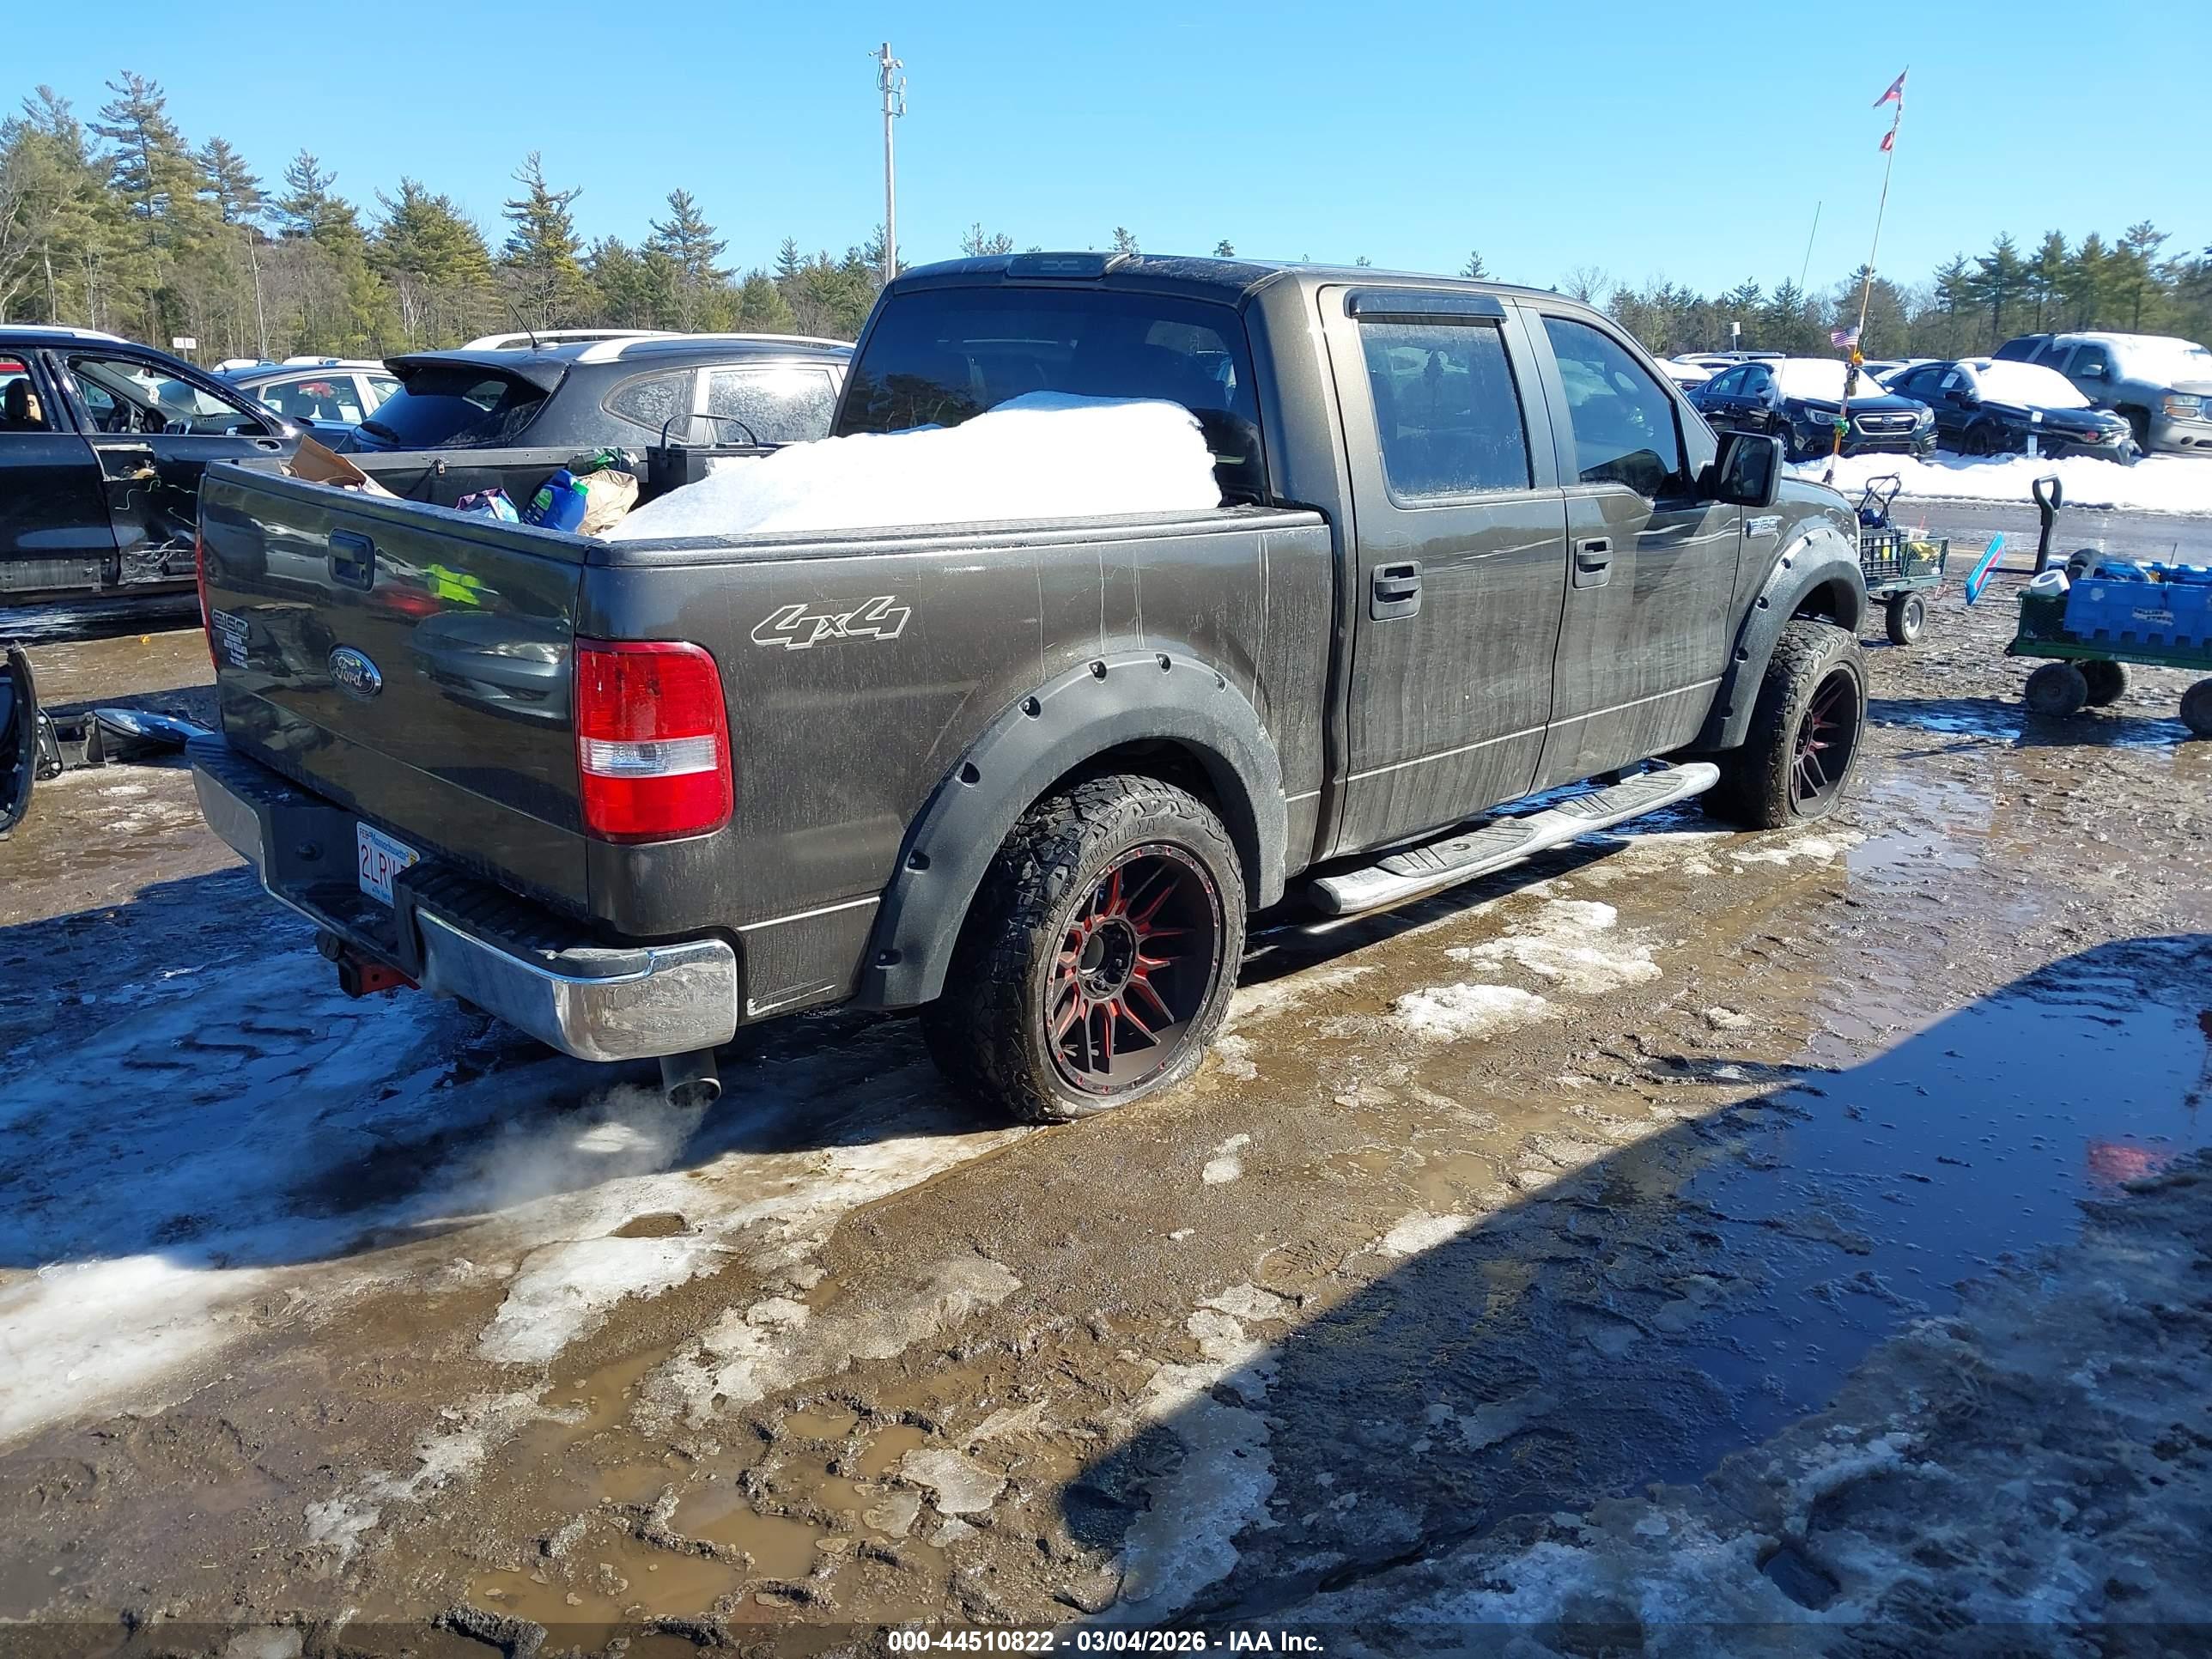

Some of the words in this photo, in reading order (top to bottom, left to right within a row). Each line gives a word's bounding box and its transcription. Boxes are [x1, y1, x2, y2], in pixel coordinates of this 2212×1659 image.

[751, 595, 912, 651] 4x4
[336, 656, 363, 687] Ford
[361, 844, 407, 890] 2LRV
